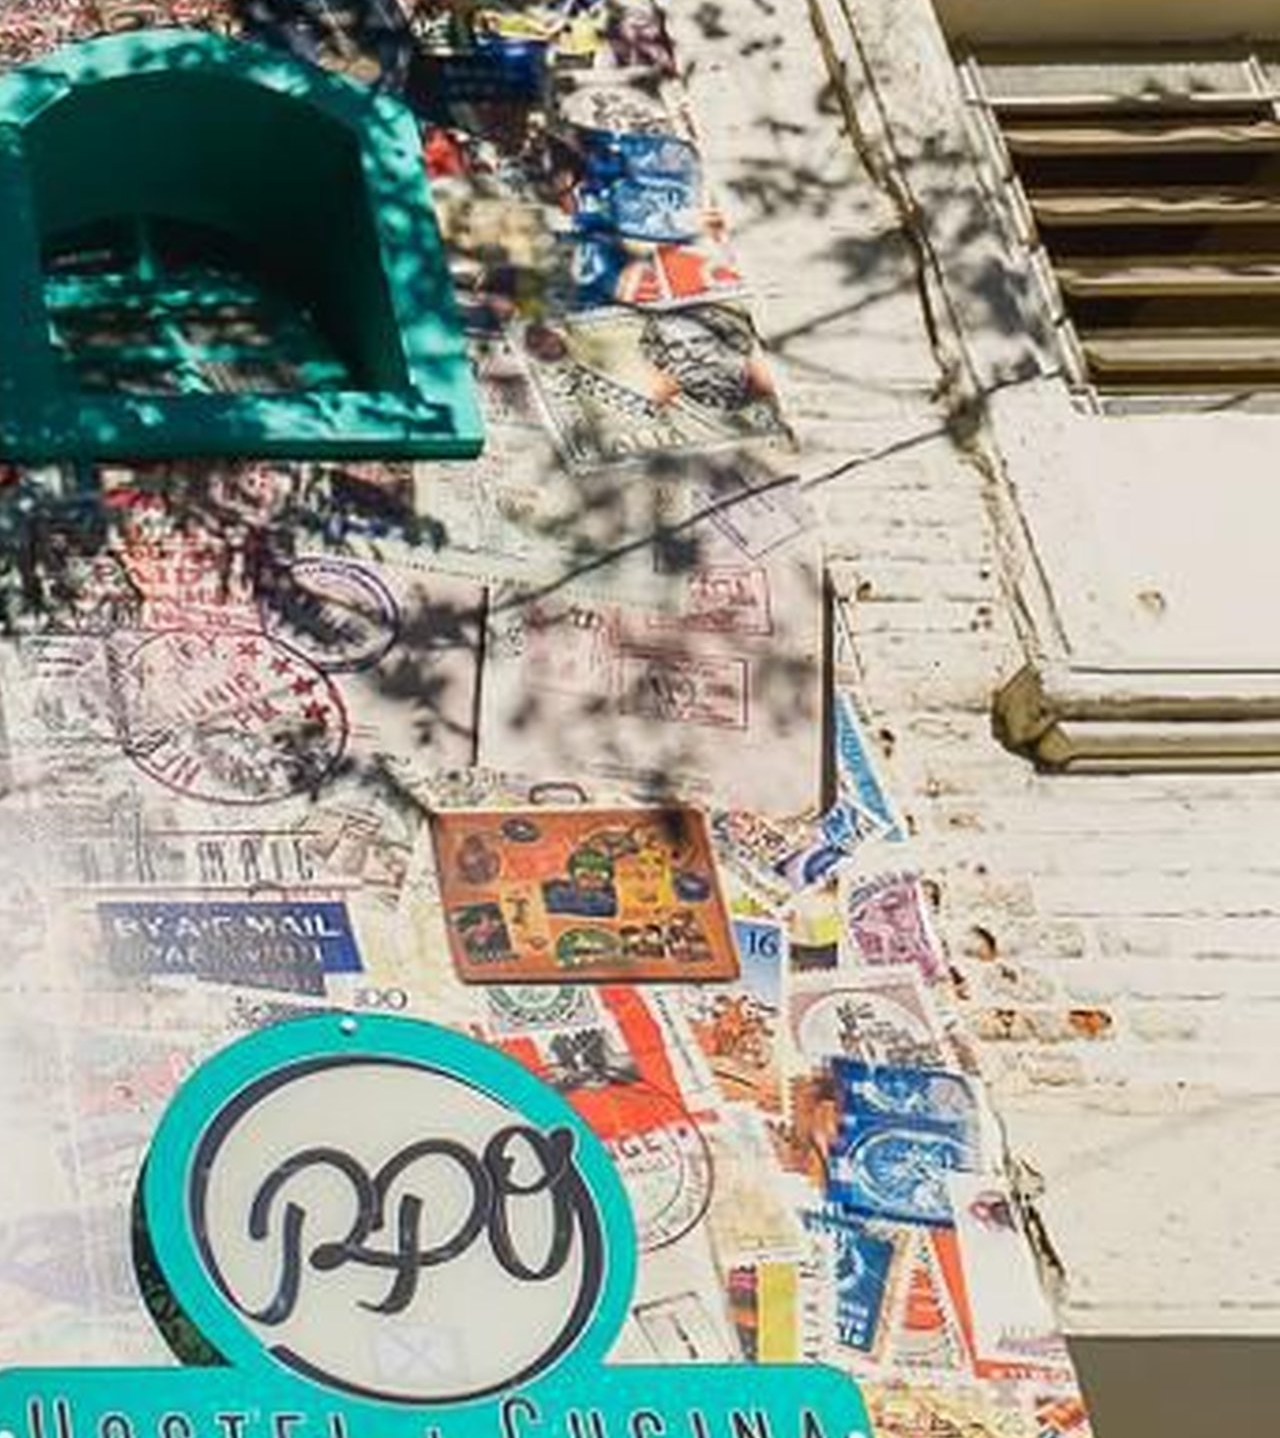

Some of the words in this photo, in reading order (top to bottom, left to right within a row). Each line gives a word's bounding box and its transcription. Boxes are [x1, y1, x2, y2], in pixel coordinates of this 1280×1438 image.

[114, 916, 163, 938] BY
[244, 914, 340, 937] MAIL
[746, 929, 780, 958] 16
